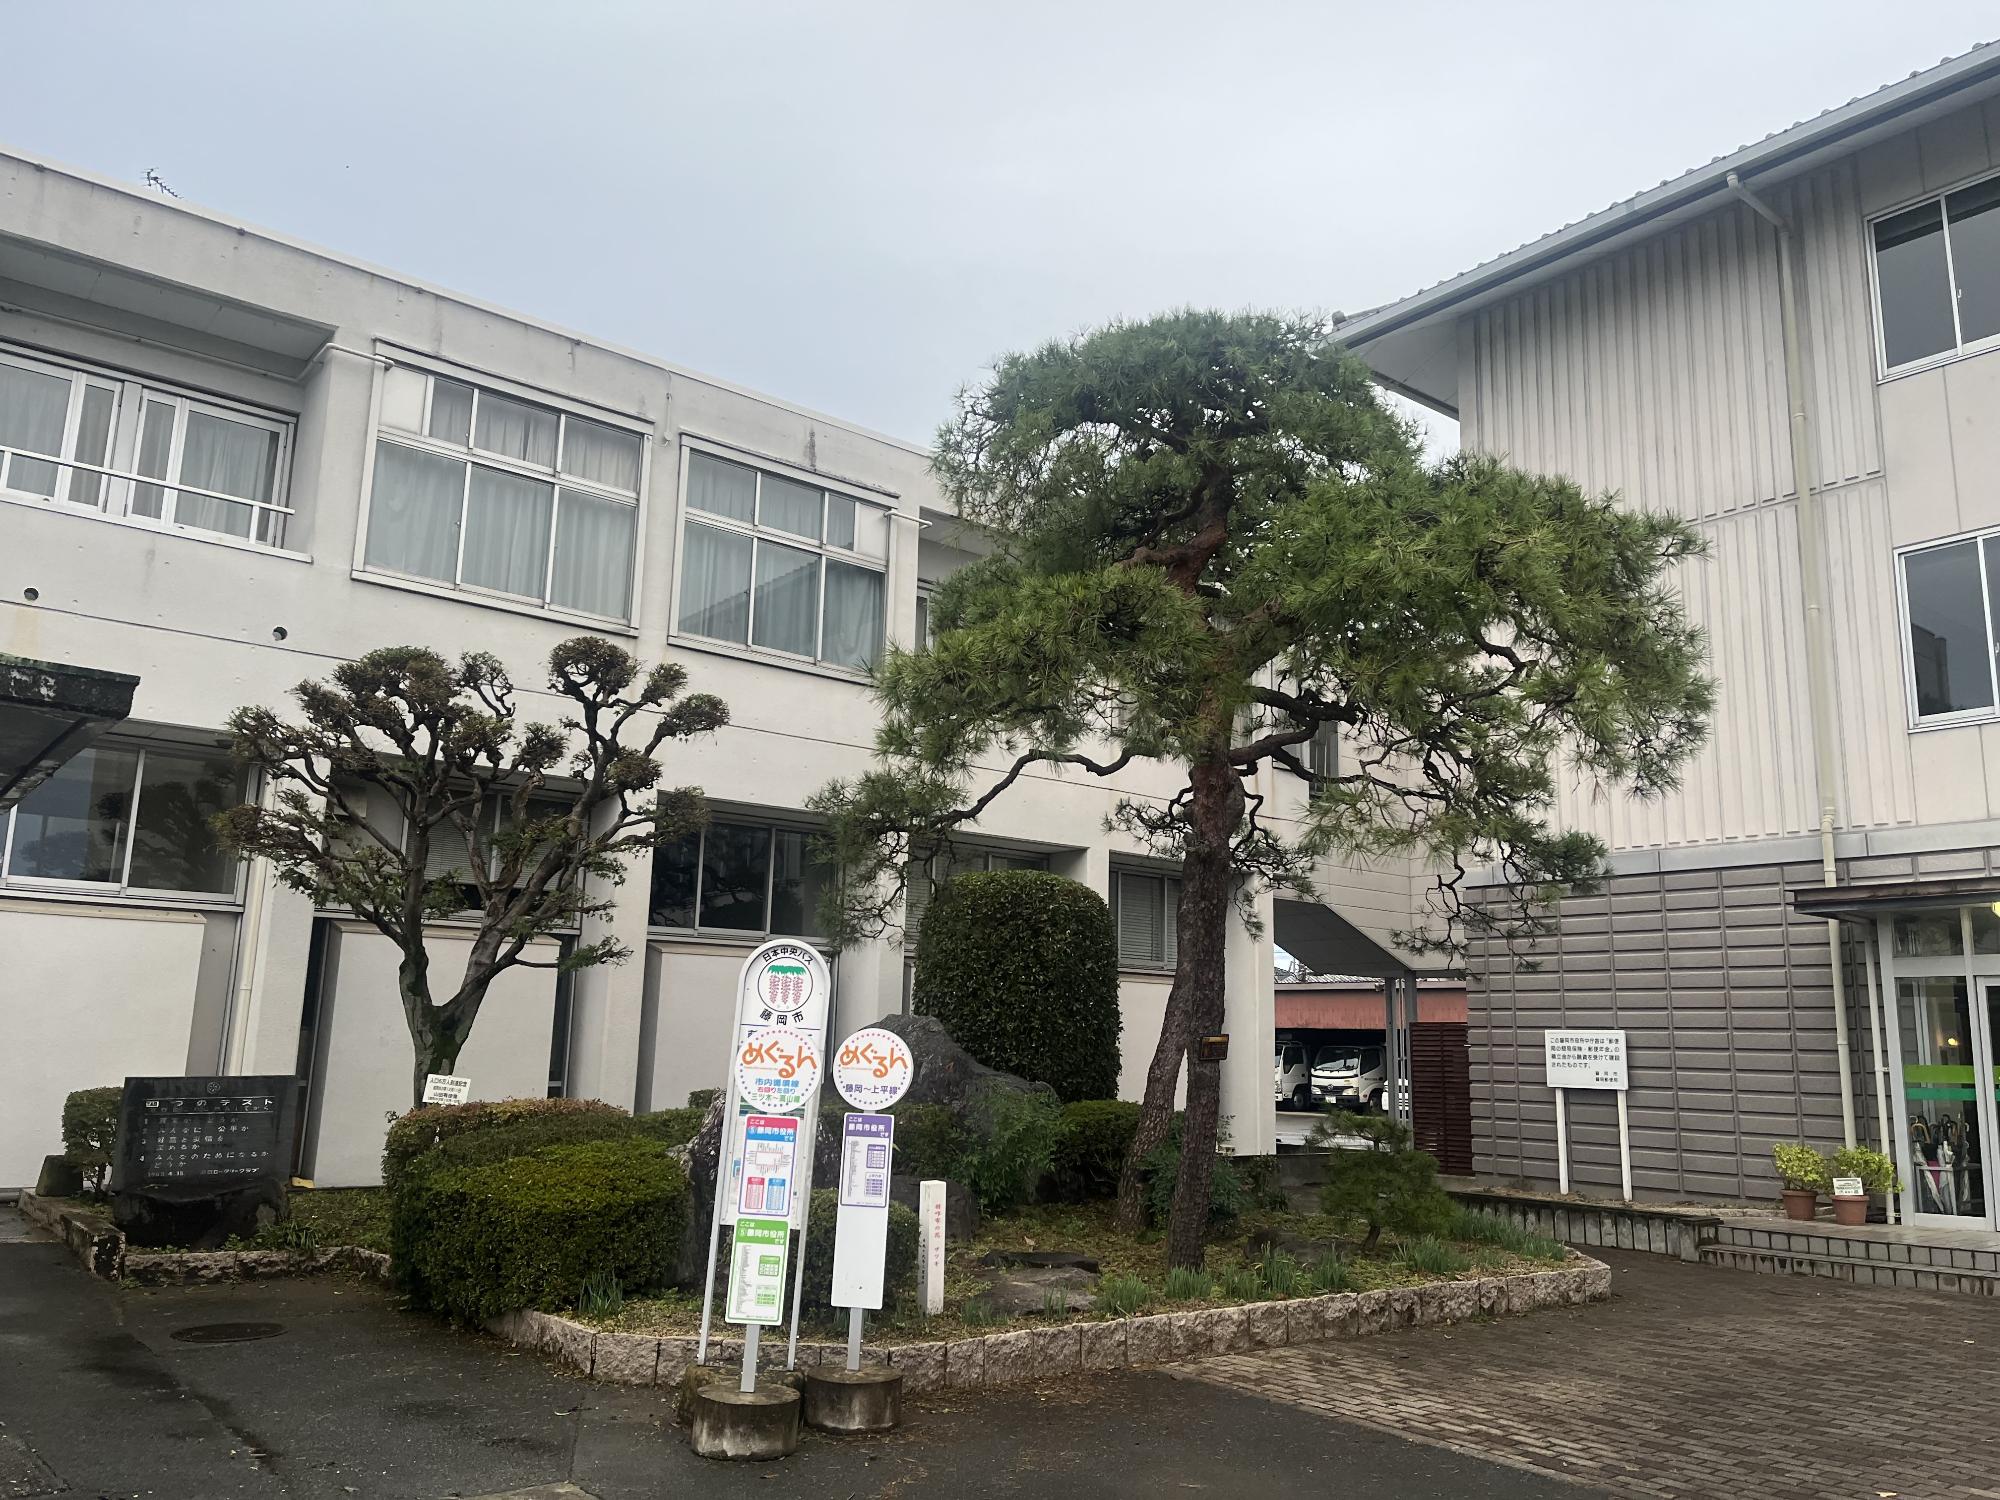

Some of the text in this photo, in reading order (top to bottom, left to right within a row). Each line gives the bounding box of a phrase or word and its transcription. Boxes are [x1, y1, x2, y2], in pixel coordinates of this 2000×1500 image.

[762, 947, 813, 965] 日本中央バス
[760, 1008, 804, 1025] 藤岡市
[742, 1040, 817, 1078] めぐるん
[839, 1042, 908, 1078] めぐるん
[757, 1126, 795, 1136] 藤岡市役所
[848, 1123, 885, 1132] 藤岡市役所
[747, 1229, 785, 1239] 藤岡市役所
